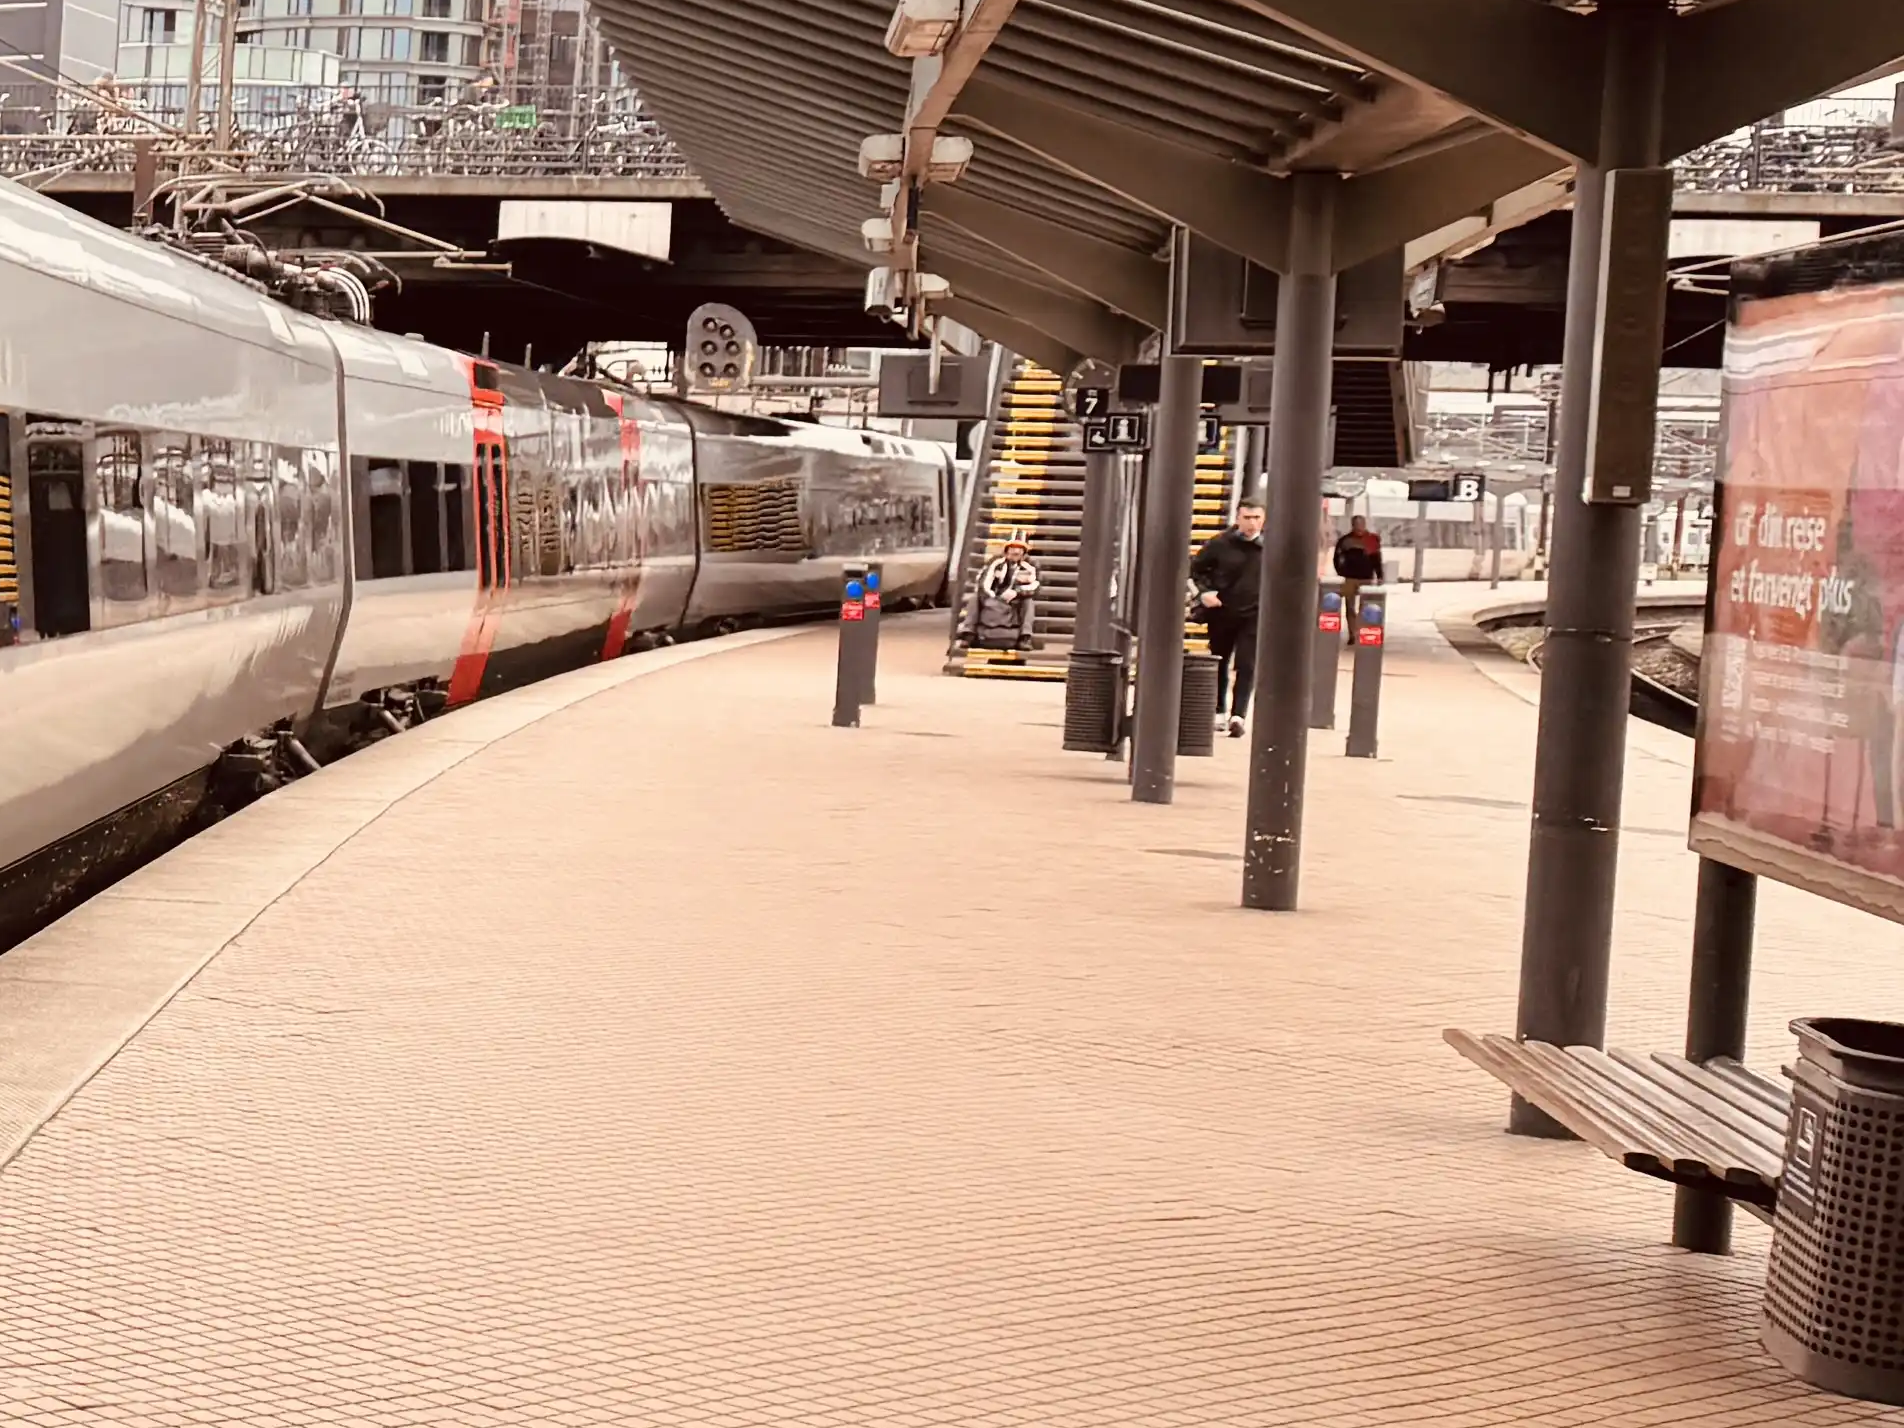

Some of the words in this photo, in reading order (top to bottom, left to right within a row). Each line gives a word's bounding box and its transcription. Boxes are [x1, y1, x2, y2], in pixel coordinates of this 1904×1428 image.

[1085, 398, 1098, 415] 7
[1758, 501, 1784, 549] din
[1785, 506, 1827, 561] rejse
[1730, 567, 1747, 603] et
[1747, 559, 1813, 620] farverigt
[1816, 564, 1855, 622] plus
